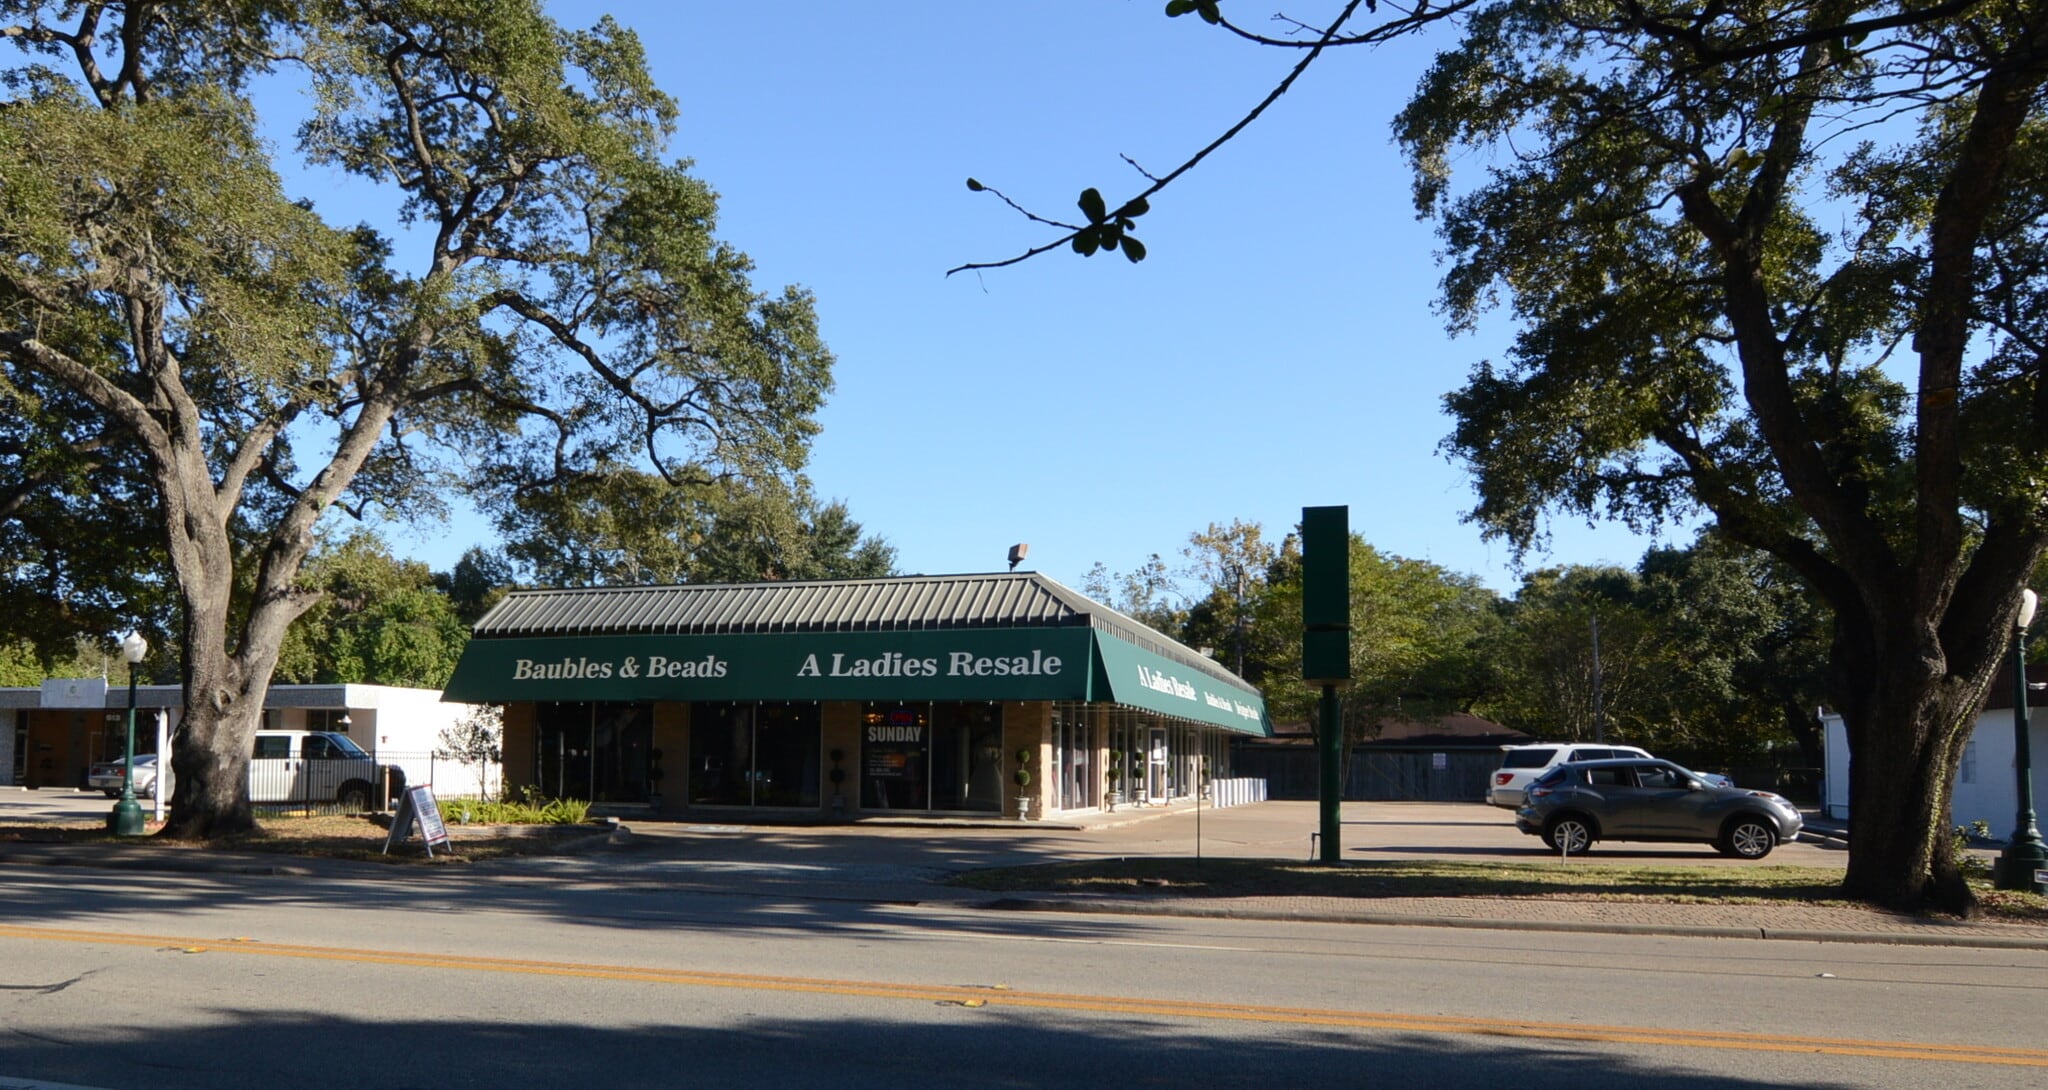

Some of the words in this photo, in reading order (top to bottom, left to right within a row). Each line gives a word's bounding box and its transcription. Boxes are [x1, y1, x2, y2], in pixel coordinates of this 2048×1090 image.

[512, 657, 612, 680] Baubles
[619, 656, 640, 678] &
[646, 655, 728, 679] Beads
[797, 653, 822, 677] A
[829, 652, 938, 677] Ladies
[946, 650, 1062, 676] Resale
[868, 725, 922, 743] SUNDAY
